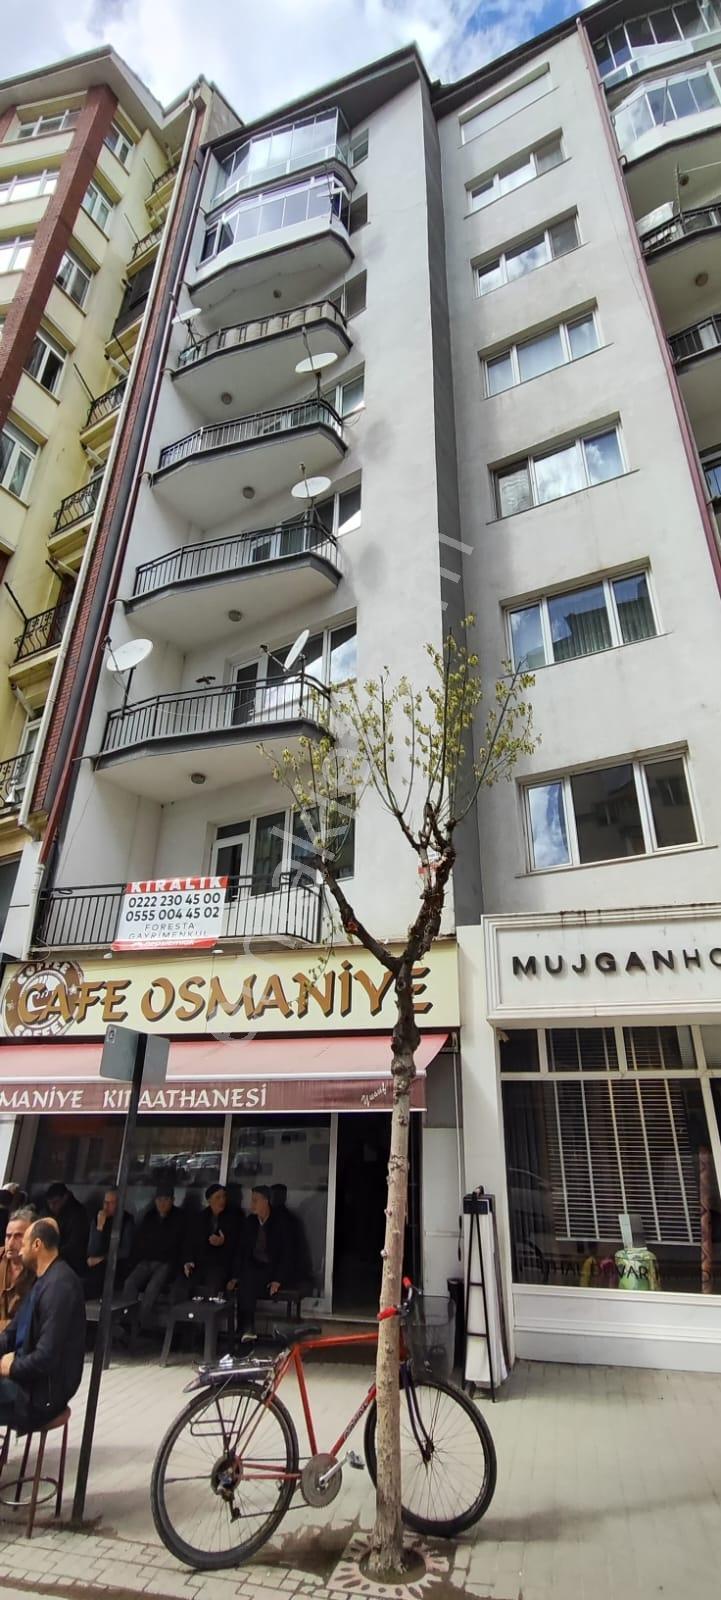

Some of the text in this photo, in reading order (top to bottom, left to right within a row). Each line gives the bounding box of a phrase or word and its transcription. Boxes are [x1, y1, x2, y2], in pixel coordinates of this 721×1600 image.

[131, 876, 222, 893] KIRALIK
[128, 892, 221, 908] 0222 230 45 00
[125, 906, 220, 922] 0555 004 45 02
[144, 922, 195, 931] FORESTA
[18, 959, 433, 1024] CAFE OSMANİYE
